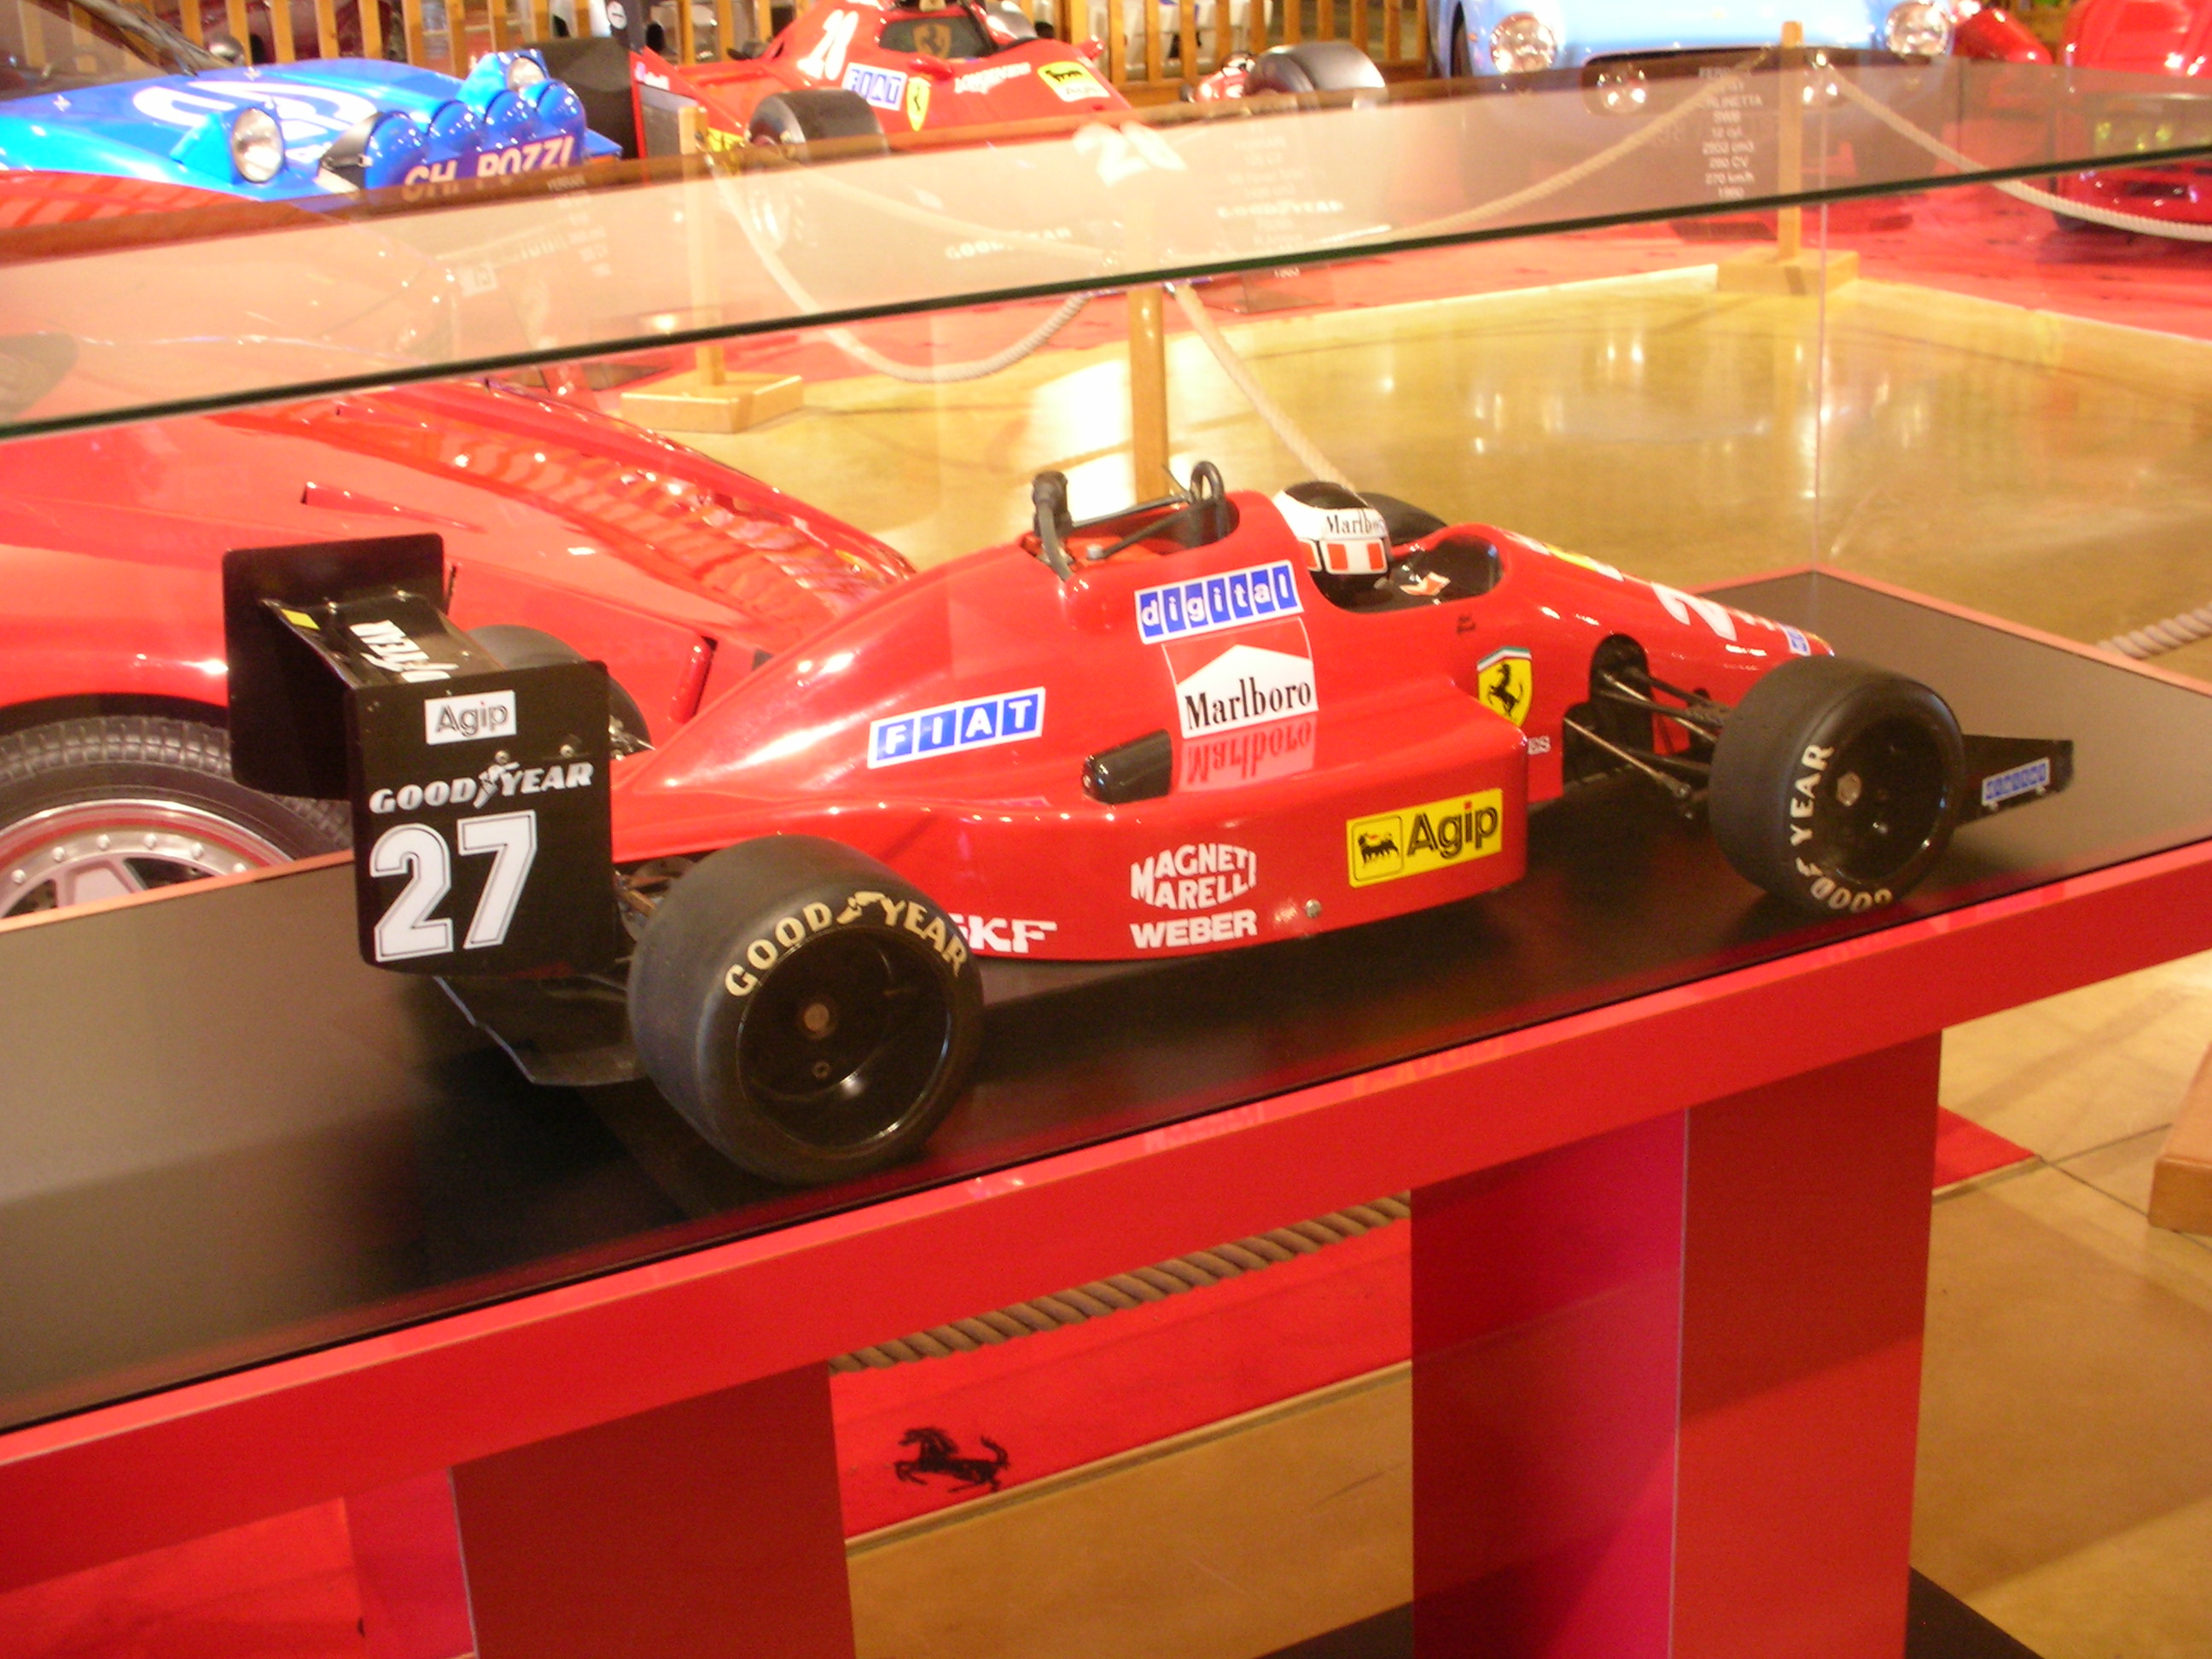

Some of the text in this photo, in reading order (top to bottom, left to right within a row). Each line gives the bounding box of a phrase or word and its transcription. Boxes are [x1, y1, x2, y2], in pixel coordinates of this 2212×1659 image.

[847, 68, 904, 104] FIAT
[476, 135, 575, 189] POZZI
[1140, 569, 1293, 628] digital
[436, 700, 509, 739] Agip
[879, 696, 1035, 756] FIAT
[1184, 677, 1313, 731] Marlboro
[1406, 801, 1499, 860] Agip
[369, 809, 538, 963] 27
[1131, 909, 1257, 949] WEBER
